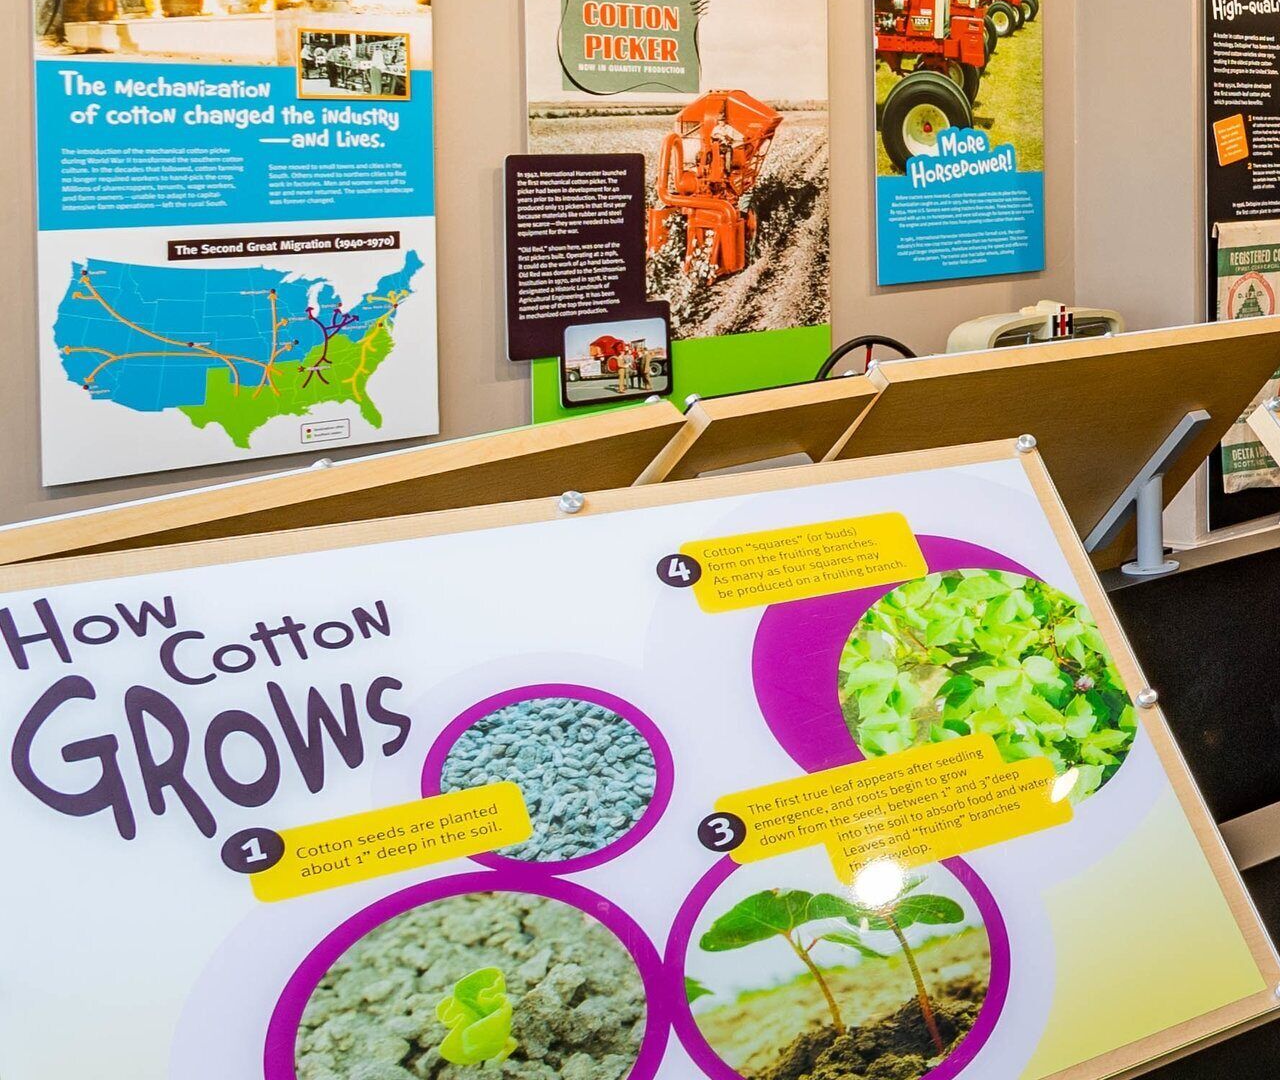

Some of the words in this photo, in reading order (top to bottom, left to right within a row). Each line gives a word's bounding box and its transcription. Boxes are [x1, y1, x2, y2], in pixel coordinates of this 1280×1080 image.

[583, 0, 679, 31] COTTON
[585, 34, 679, 62] PICKER
[578, 63, 595, 71] NOW
[644, 66, 685, 74] PRODUCTION
[58, 70, 106, 97] The
[70, 103, 100, 125] of
[106, 106, 176, 125] cotton
[183, 104, 274, 129] changed
[281, 107, 314, 125] the
[174, 244, 198, 255] The
[201, 243, 243, 255] Second
[246, 241, 278, 252] Great
[280, 238, 332, 251] Migration
[335, 236, 395, 250] (1940-1970)
[1230, 249, 1270, 265] REGISTERED
[703, 542, 744, 559] Cotton
[807, 533, 823, 544] (or
[825, 527, 857, 541] buds)
[668, 558, 690, 581] 4
[0, 595, 178, 670] How
[296, 838, 353, 860] Cotton
[357, 827, 406, 845] seeds
[410, 820, 435, 835] are
[439, 804, 497, 829] planted
[713, 818, 735, 847] 3
[241, 837, 268, 863] 1
[300, 859, 351, 878] about
[376, 841, 418, 860] deep
[421, 837, 436, 849] in
[439, 830, 466, 845] the
[470, 821, 503, 840] soil.
